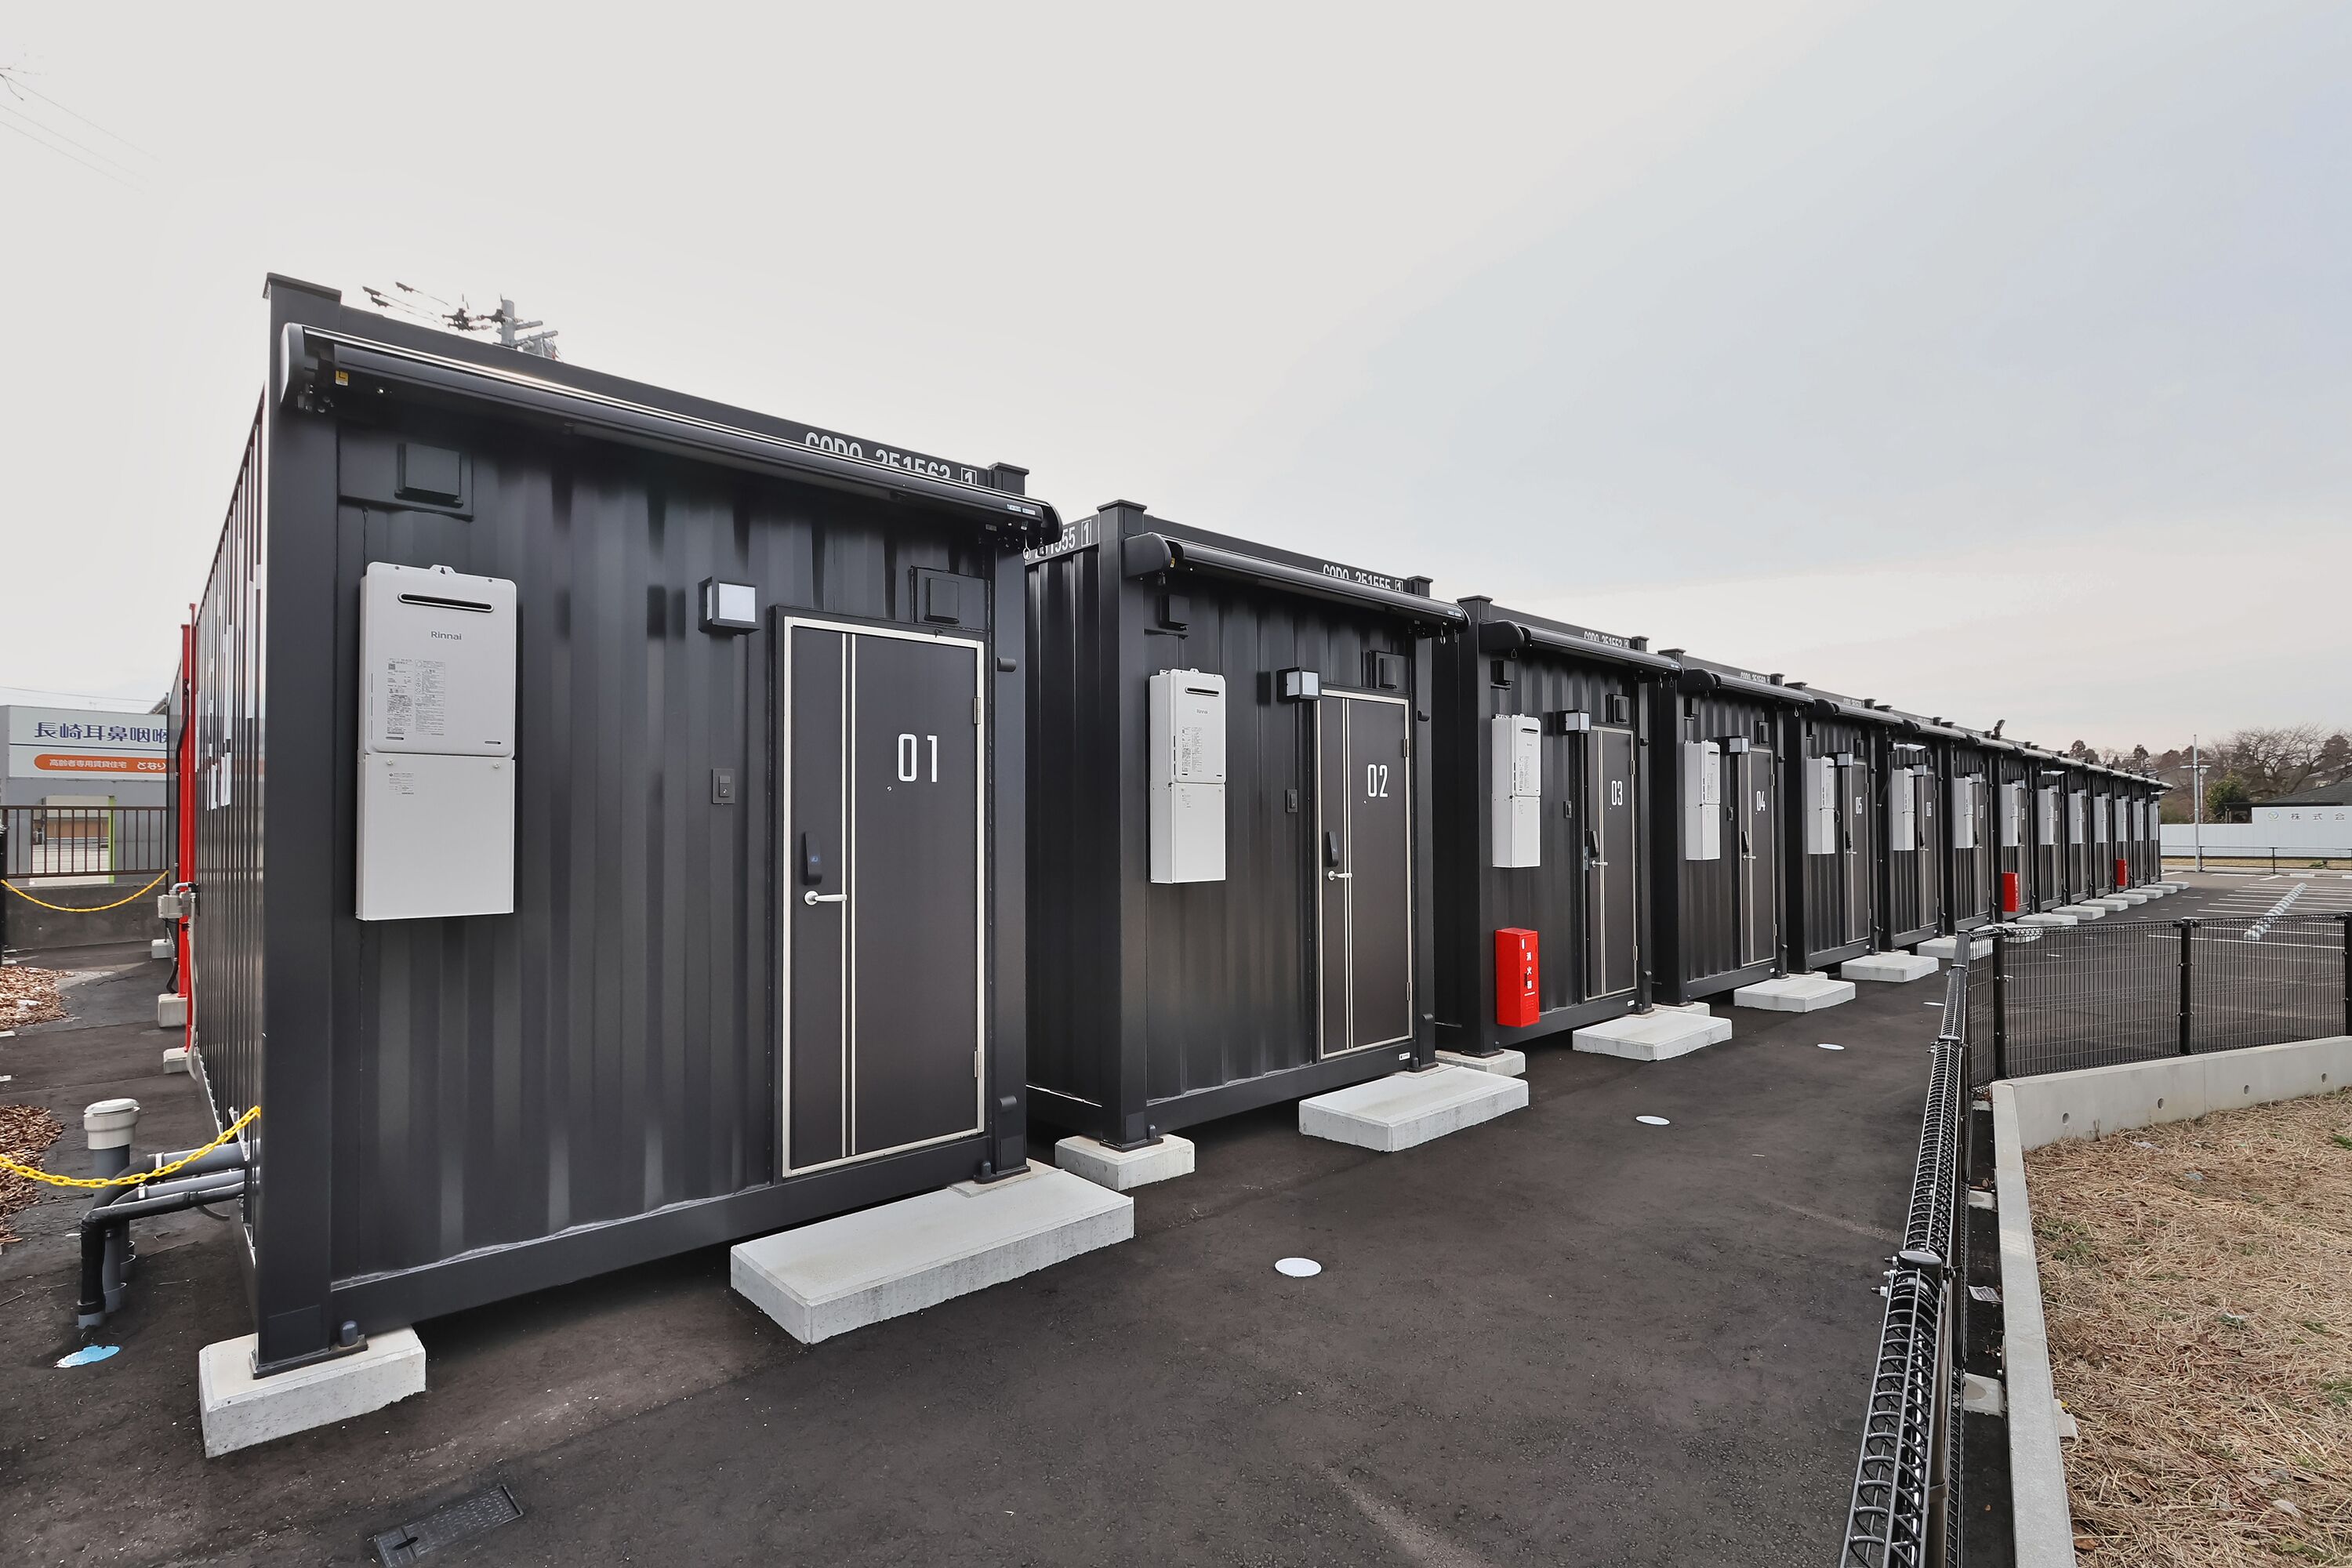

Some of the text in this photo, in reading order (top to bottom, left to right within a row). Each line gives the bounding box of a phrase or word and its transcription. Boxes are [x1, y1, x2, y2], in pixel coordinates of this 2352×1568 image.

[431, 630, 462, 641] Rinnai
[898, 733, 938, 782] 01
[1367, 764, 1388, 797] 02
[1611, 780, 1623, 806] 03
[1756, 790, 1766, 811] 04
